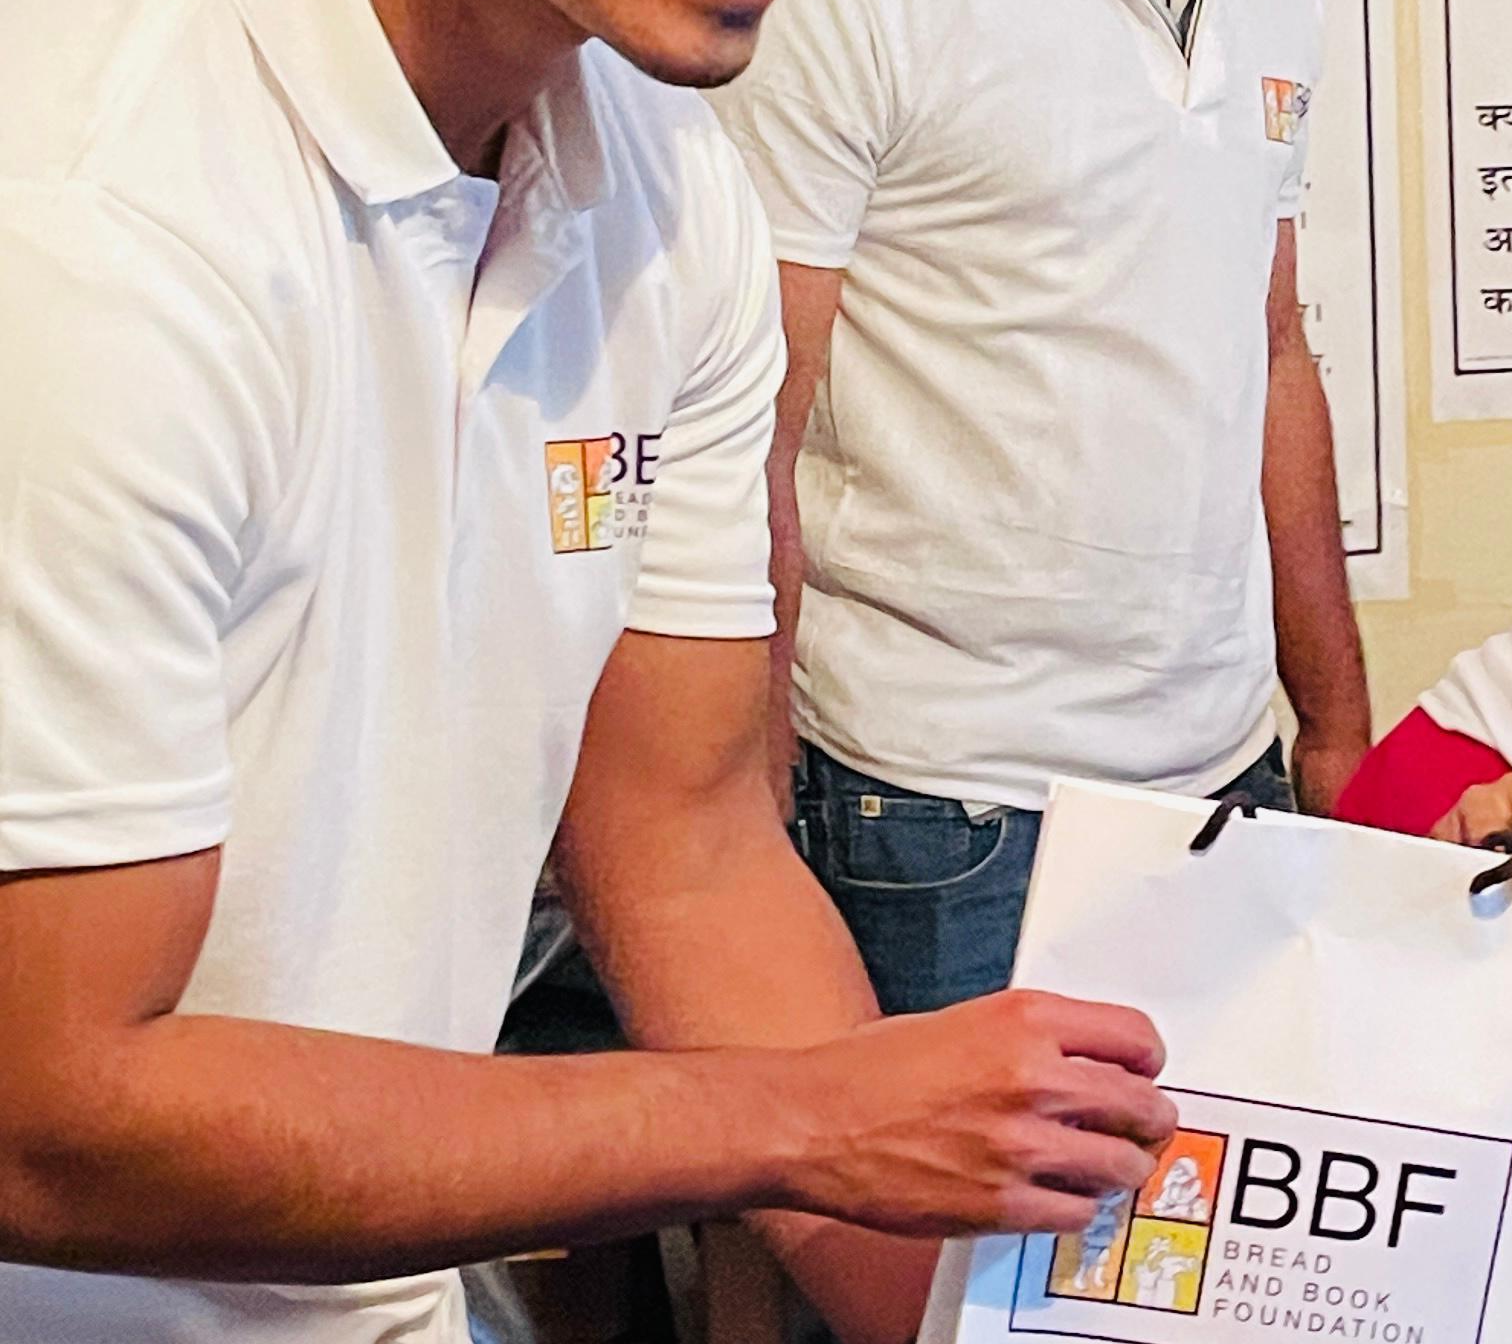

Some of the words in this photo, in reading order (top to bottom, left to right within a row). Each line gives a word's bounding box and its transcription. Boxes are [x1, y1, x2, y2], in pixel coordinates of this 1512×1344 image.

[1229, 1137, 1458, 1249] BBF
[1224, 1240, 1332, 1274] BREAD
[1216, 1268, 1283, 1297] AND
[1302, 1282, 1391, 1313] BOOK
[1212, 1297, 1424, 1344] FOUNDATION
